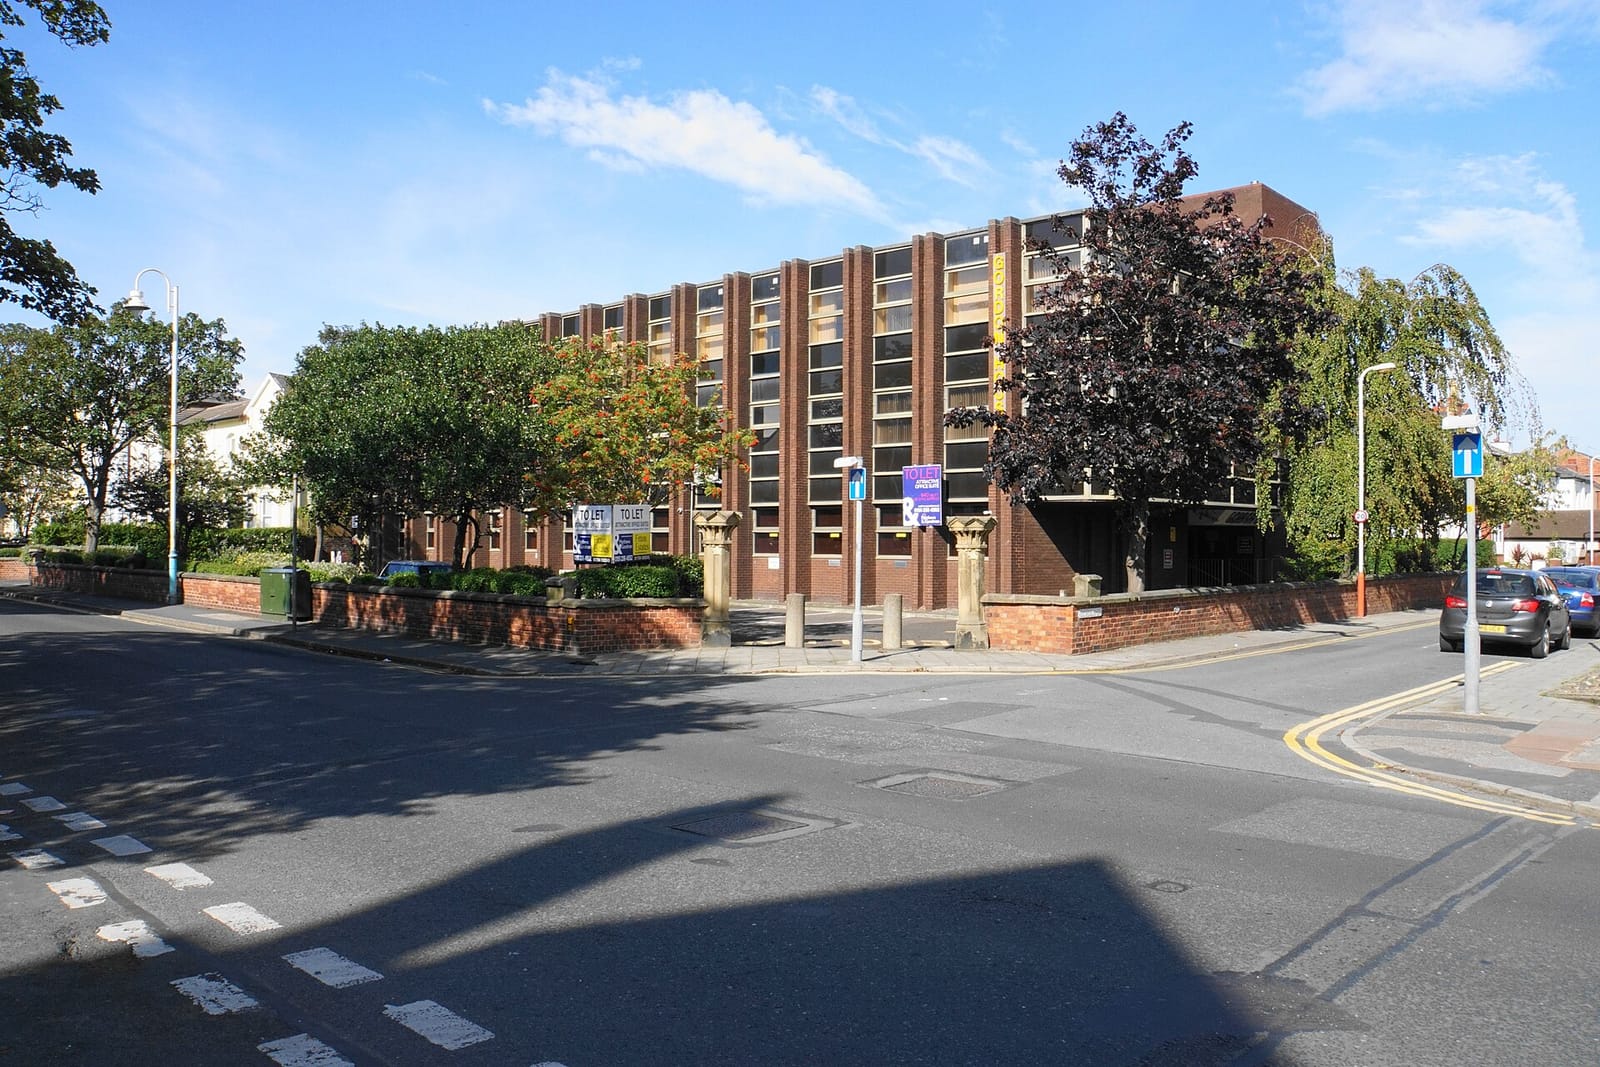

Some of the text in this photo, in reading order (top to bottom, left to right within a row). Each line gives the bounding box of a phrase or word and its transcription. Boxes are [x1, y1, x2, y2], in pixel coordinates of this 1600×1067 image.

[993, 255, 1005, 344] GORDON
[904, 466, 939, 480] TO LET
[580, 509, 604, 520] TO LET
[620, 508, 643, 520] TO LET
